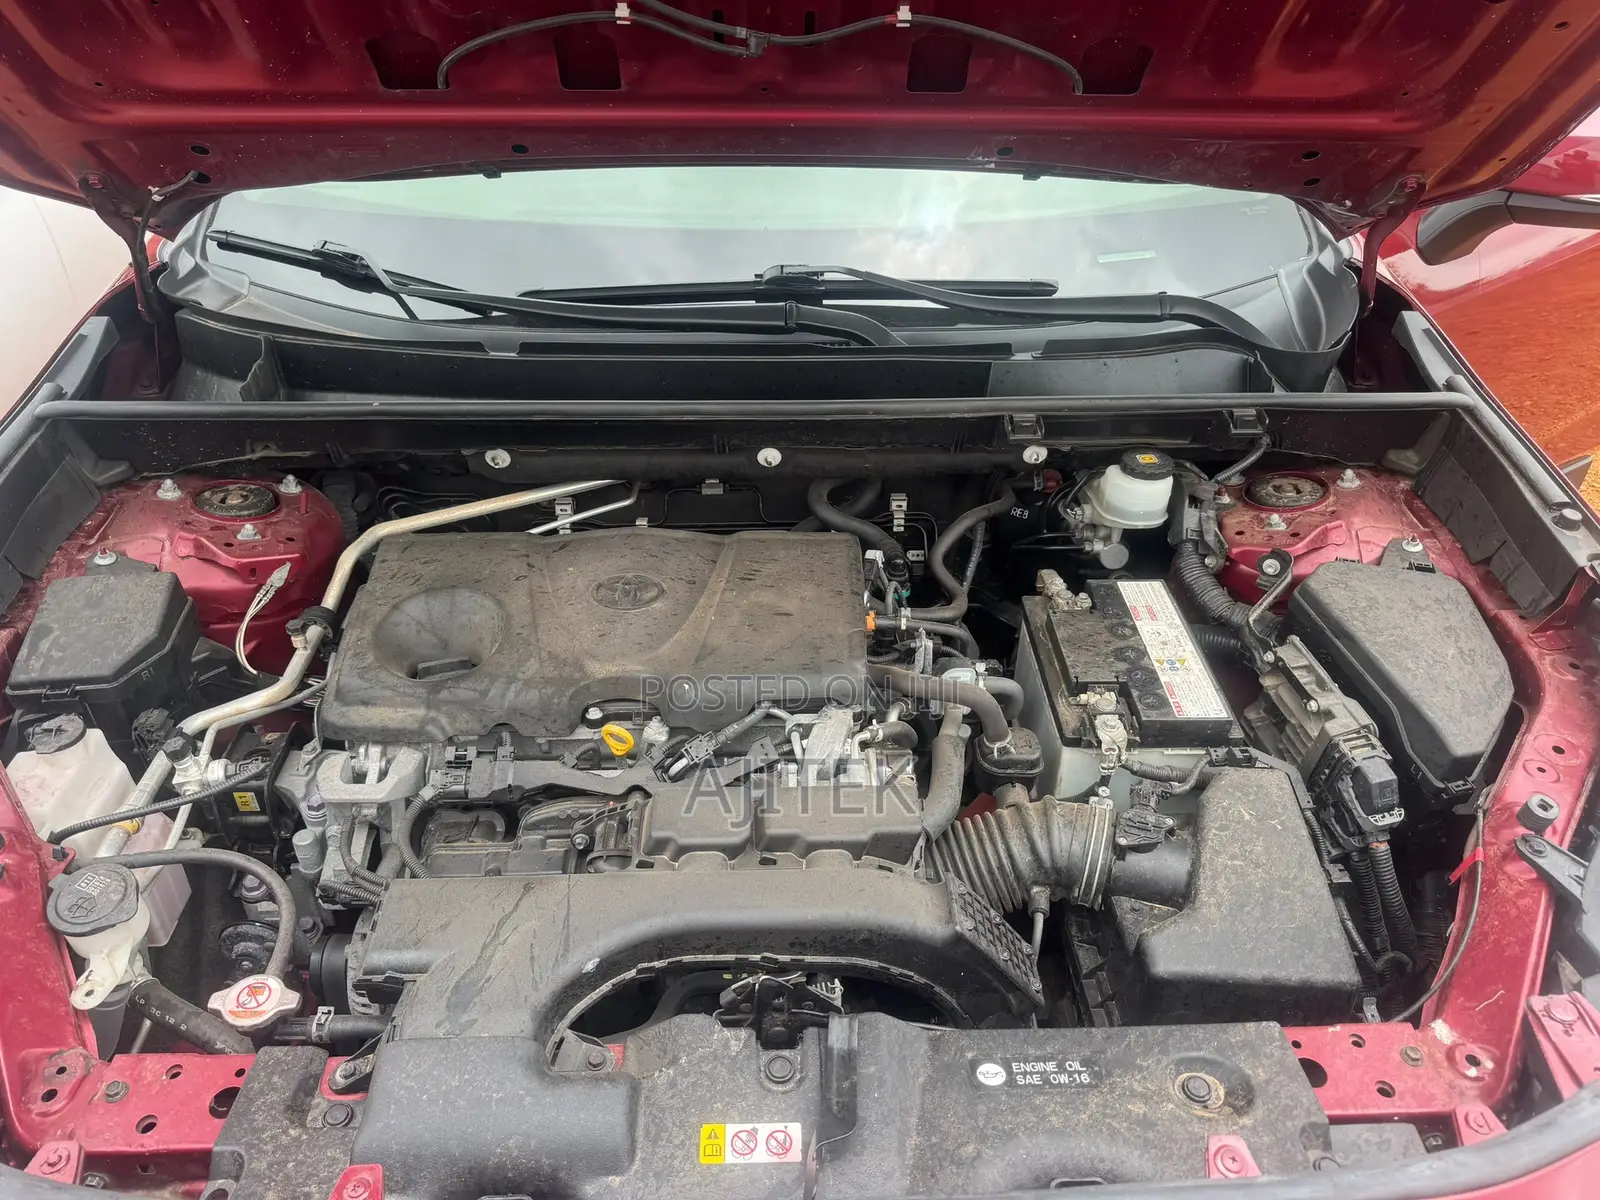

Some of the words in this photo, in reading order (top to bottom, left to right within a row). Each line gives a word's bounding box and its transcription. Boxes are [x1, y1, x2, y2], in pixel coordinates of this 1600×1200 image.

[1010, 506, 1029, 519] RE8
[165, 1015, 175, 1024] 12
[180, 1023, 187, 1031] 2
[1012, 1062, 1058, 1072] ENGINE
[1065, 1061, 1087, 1071] OIL
[1016, 1074, 1043, 1085] SAE
[1050, 1073, 1090, 1084] 0W-16
